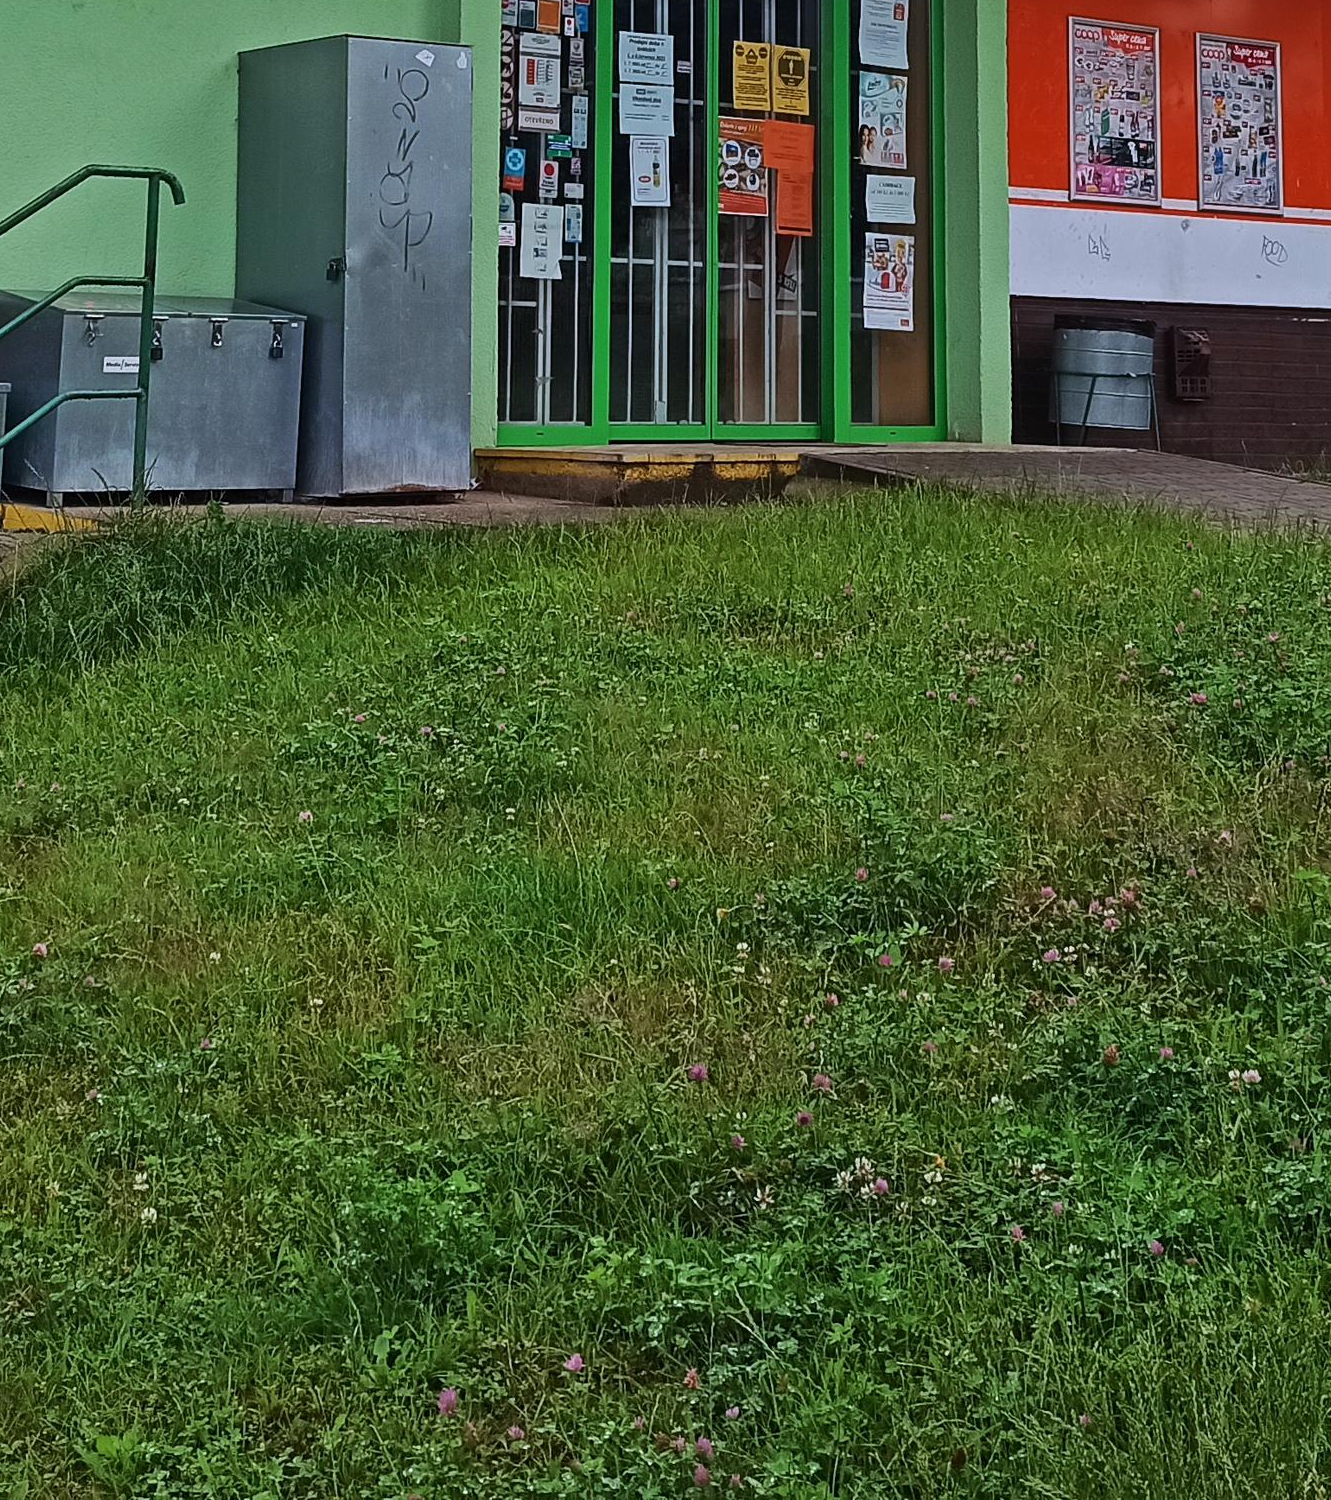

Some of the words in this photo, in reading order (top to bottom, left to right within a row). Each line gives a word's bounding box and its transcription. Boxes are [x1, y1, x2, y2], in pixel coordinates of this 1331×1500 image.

[1075, 28, 1101, 42] coop
[1109, 29, 1129, 45] Super
[1201, 48, 1225, 62] coop
[1233, 44, 1252, 60] Super
